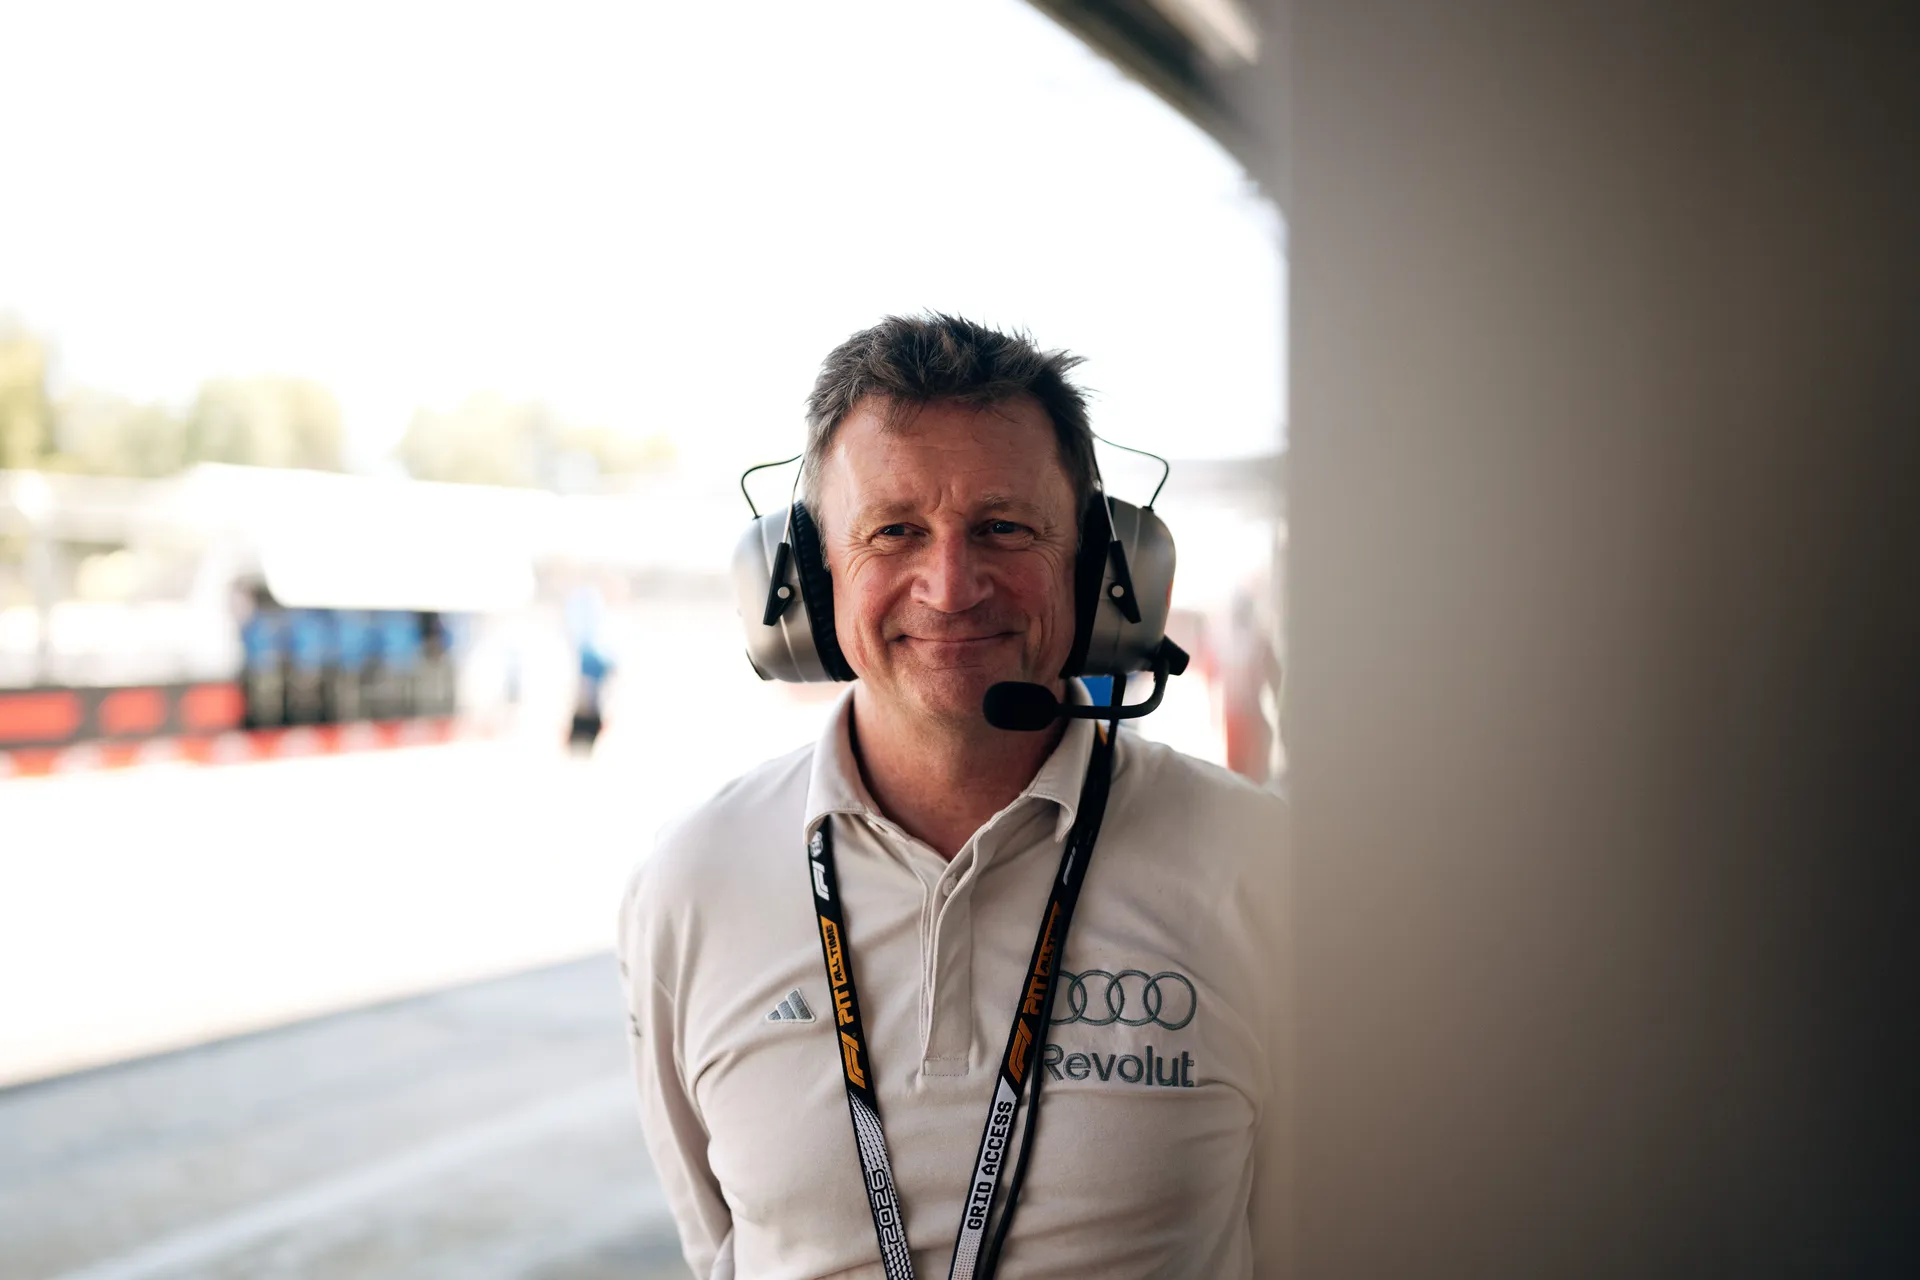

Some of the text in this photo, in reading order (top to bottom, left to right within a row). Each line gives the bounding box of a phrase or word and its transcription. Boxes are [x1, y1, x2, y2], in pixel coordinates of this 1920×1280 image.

[811, 860, 829, 901] F1
[826, 923, 866, 1089] F1 PIT ALL TIME
[1008, 1017, 1032, 1084] F1
[1023, 976, 1047, 1015] PIT
[1043, 1044, 1195, 1087] Revolut
[868, 1169, 898, 1248] 2026
[967, 1100, 1013, 1231] GRID ACCESS
